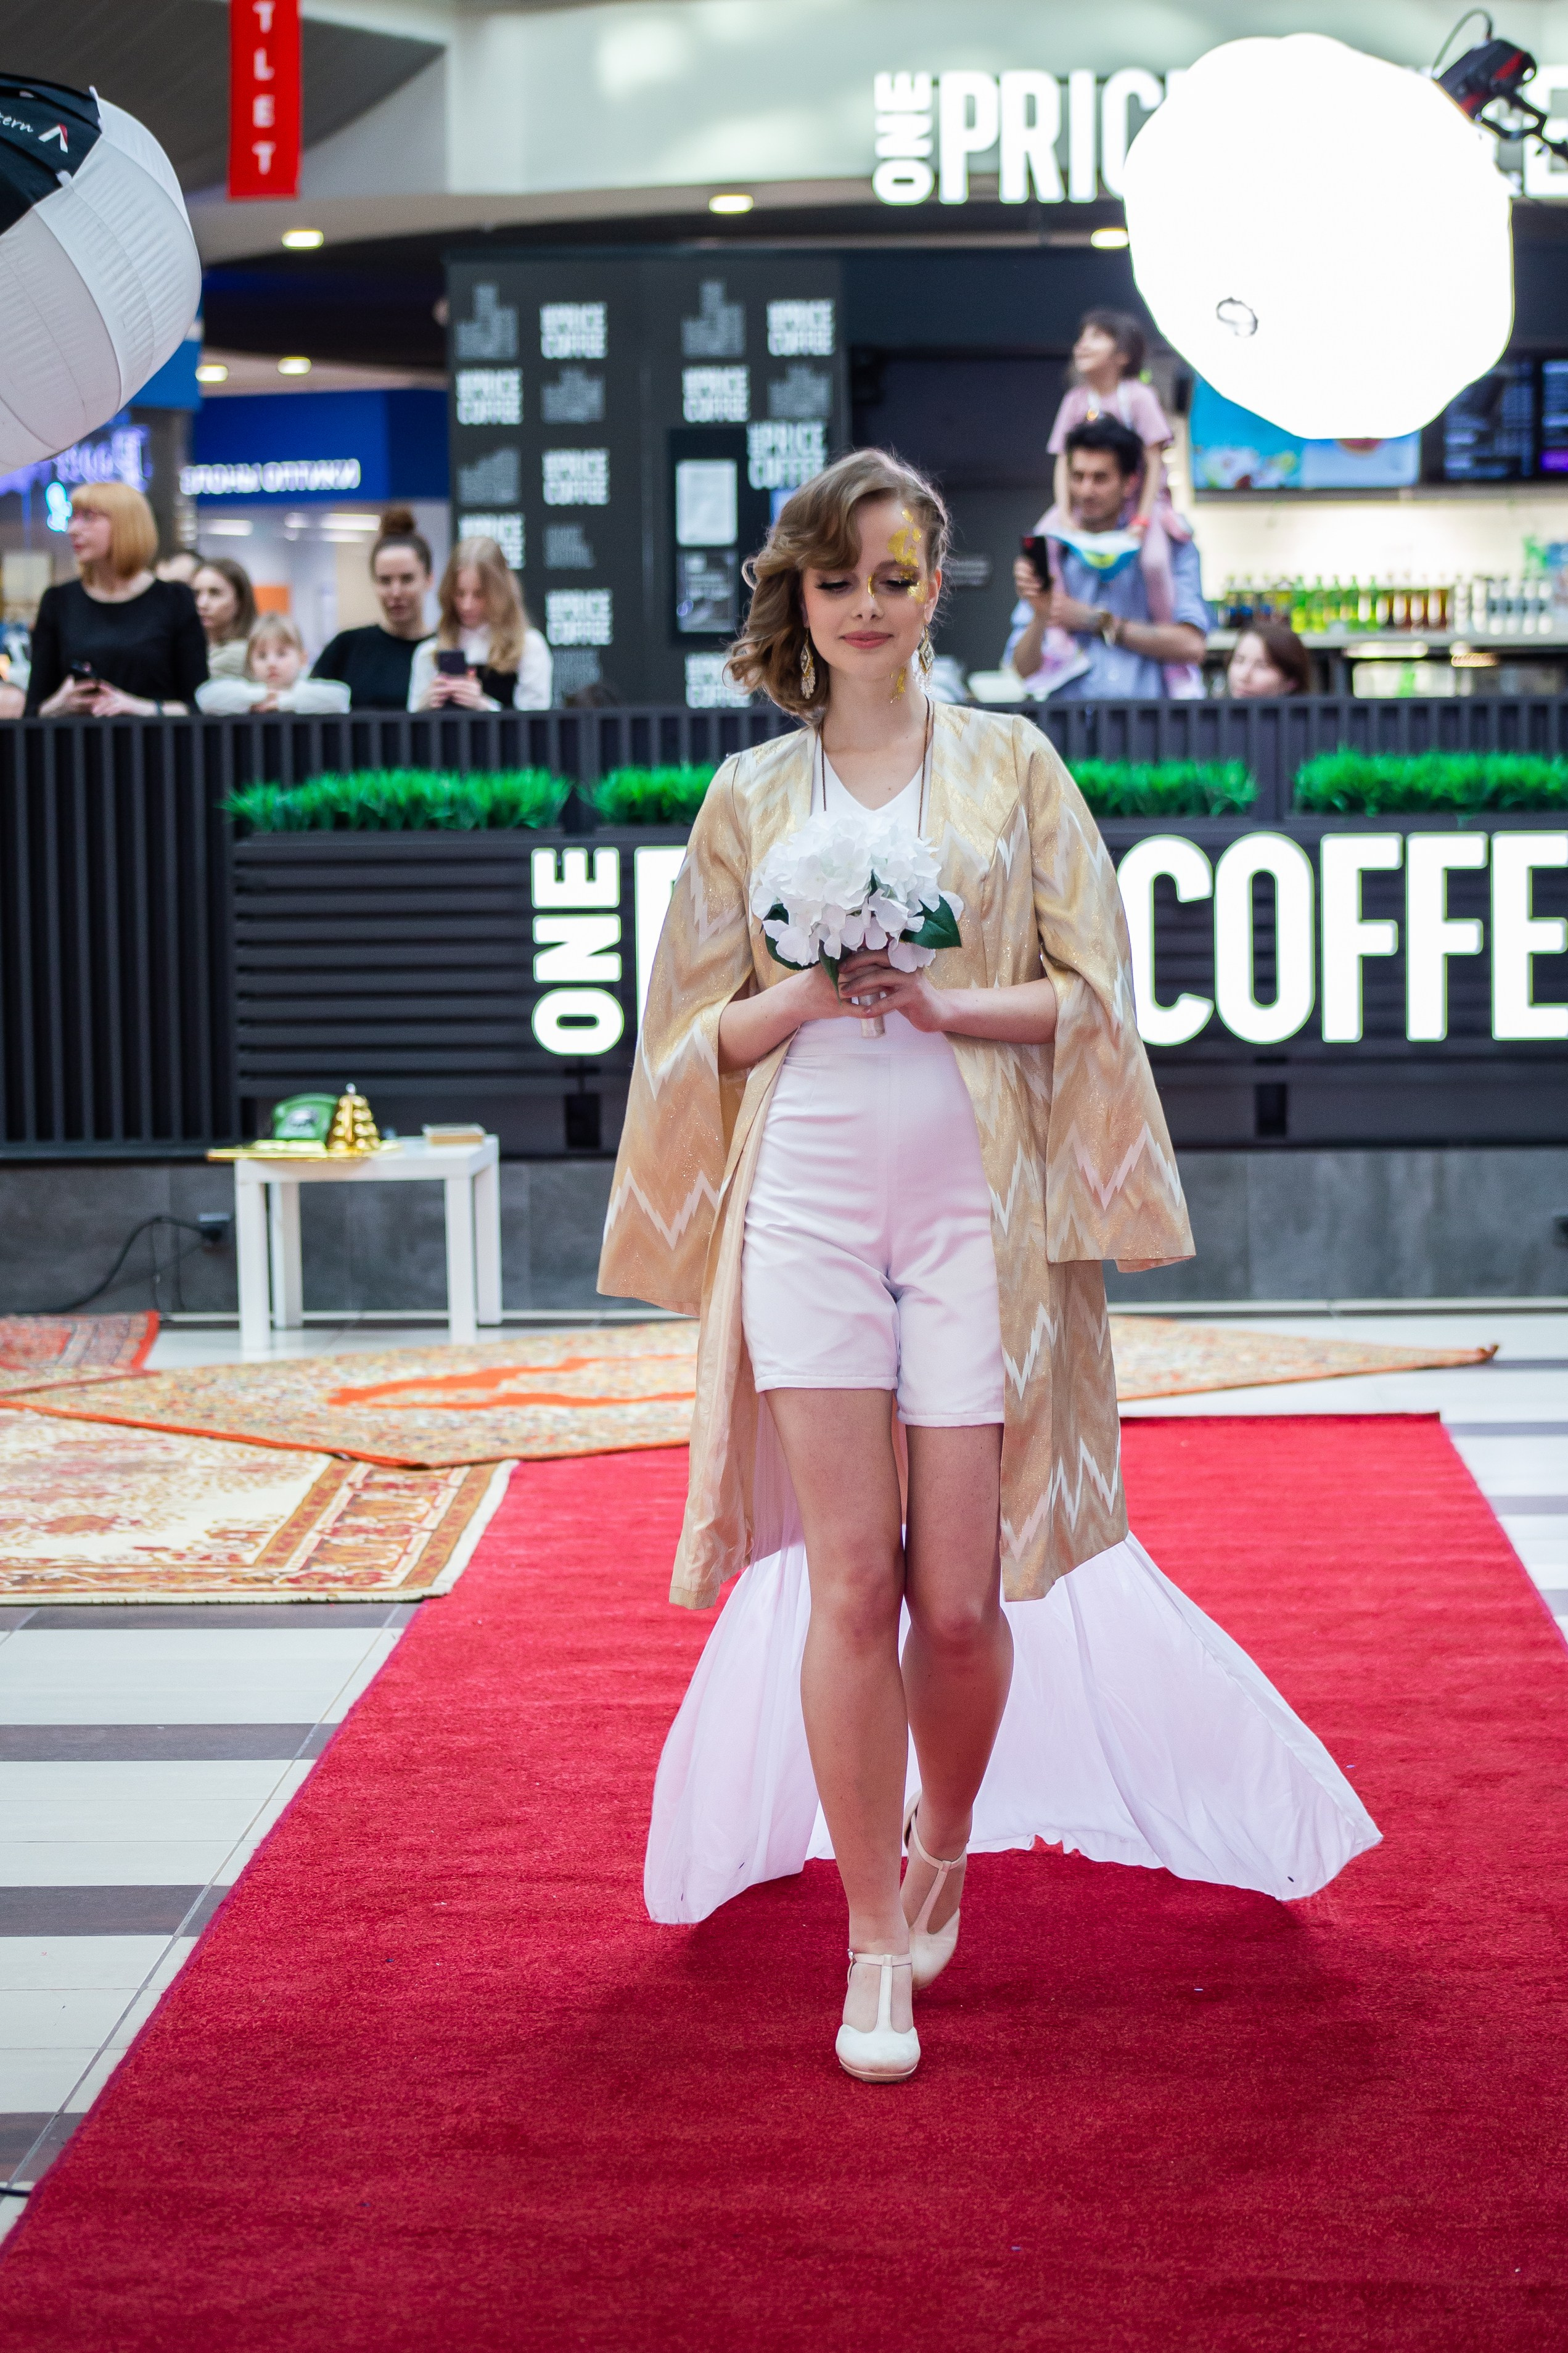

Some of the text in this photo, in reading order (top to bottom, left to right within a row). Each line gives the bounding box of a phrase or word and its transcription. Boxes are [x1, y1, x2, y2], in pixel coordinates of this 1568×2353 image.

[0, 111, 33, 133] ern
[251, 1, 276, 175] TLET
[872, 68, 1187, 205] ONE PRIC
[531, 847, 624, 1055] ONE
[1117, 831, 1568, 1046] COFFE
